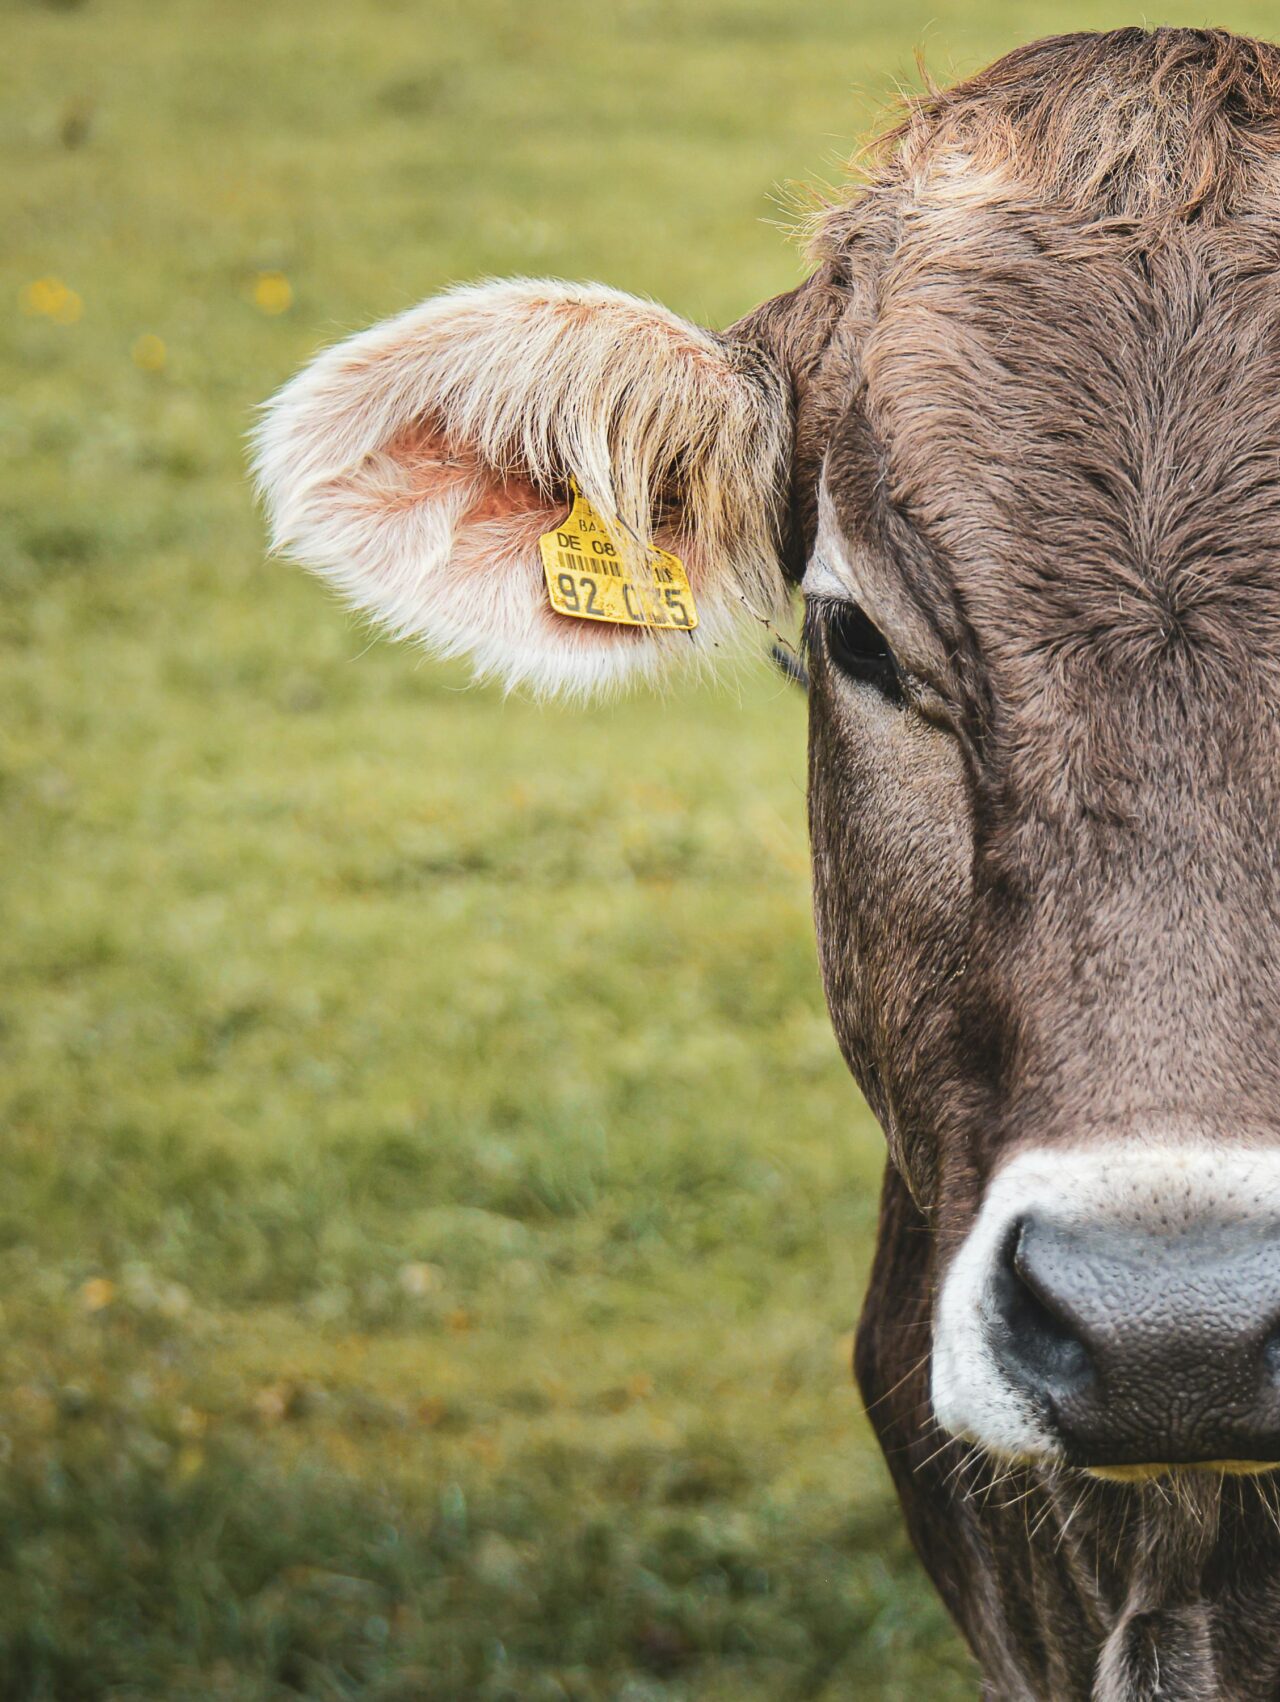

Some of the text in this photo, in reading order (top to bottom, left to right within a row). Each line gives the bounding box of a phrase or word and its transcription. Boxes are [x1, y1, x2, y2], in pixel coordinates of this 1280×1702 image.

[557, 532, 617, 557] DE 08
[558, 573, 690, 627] 92 05
